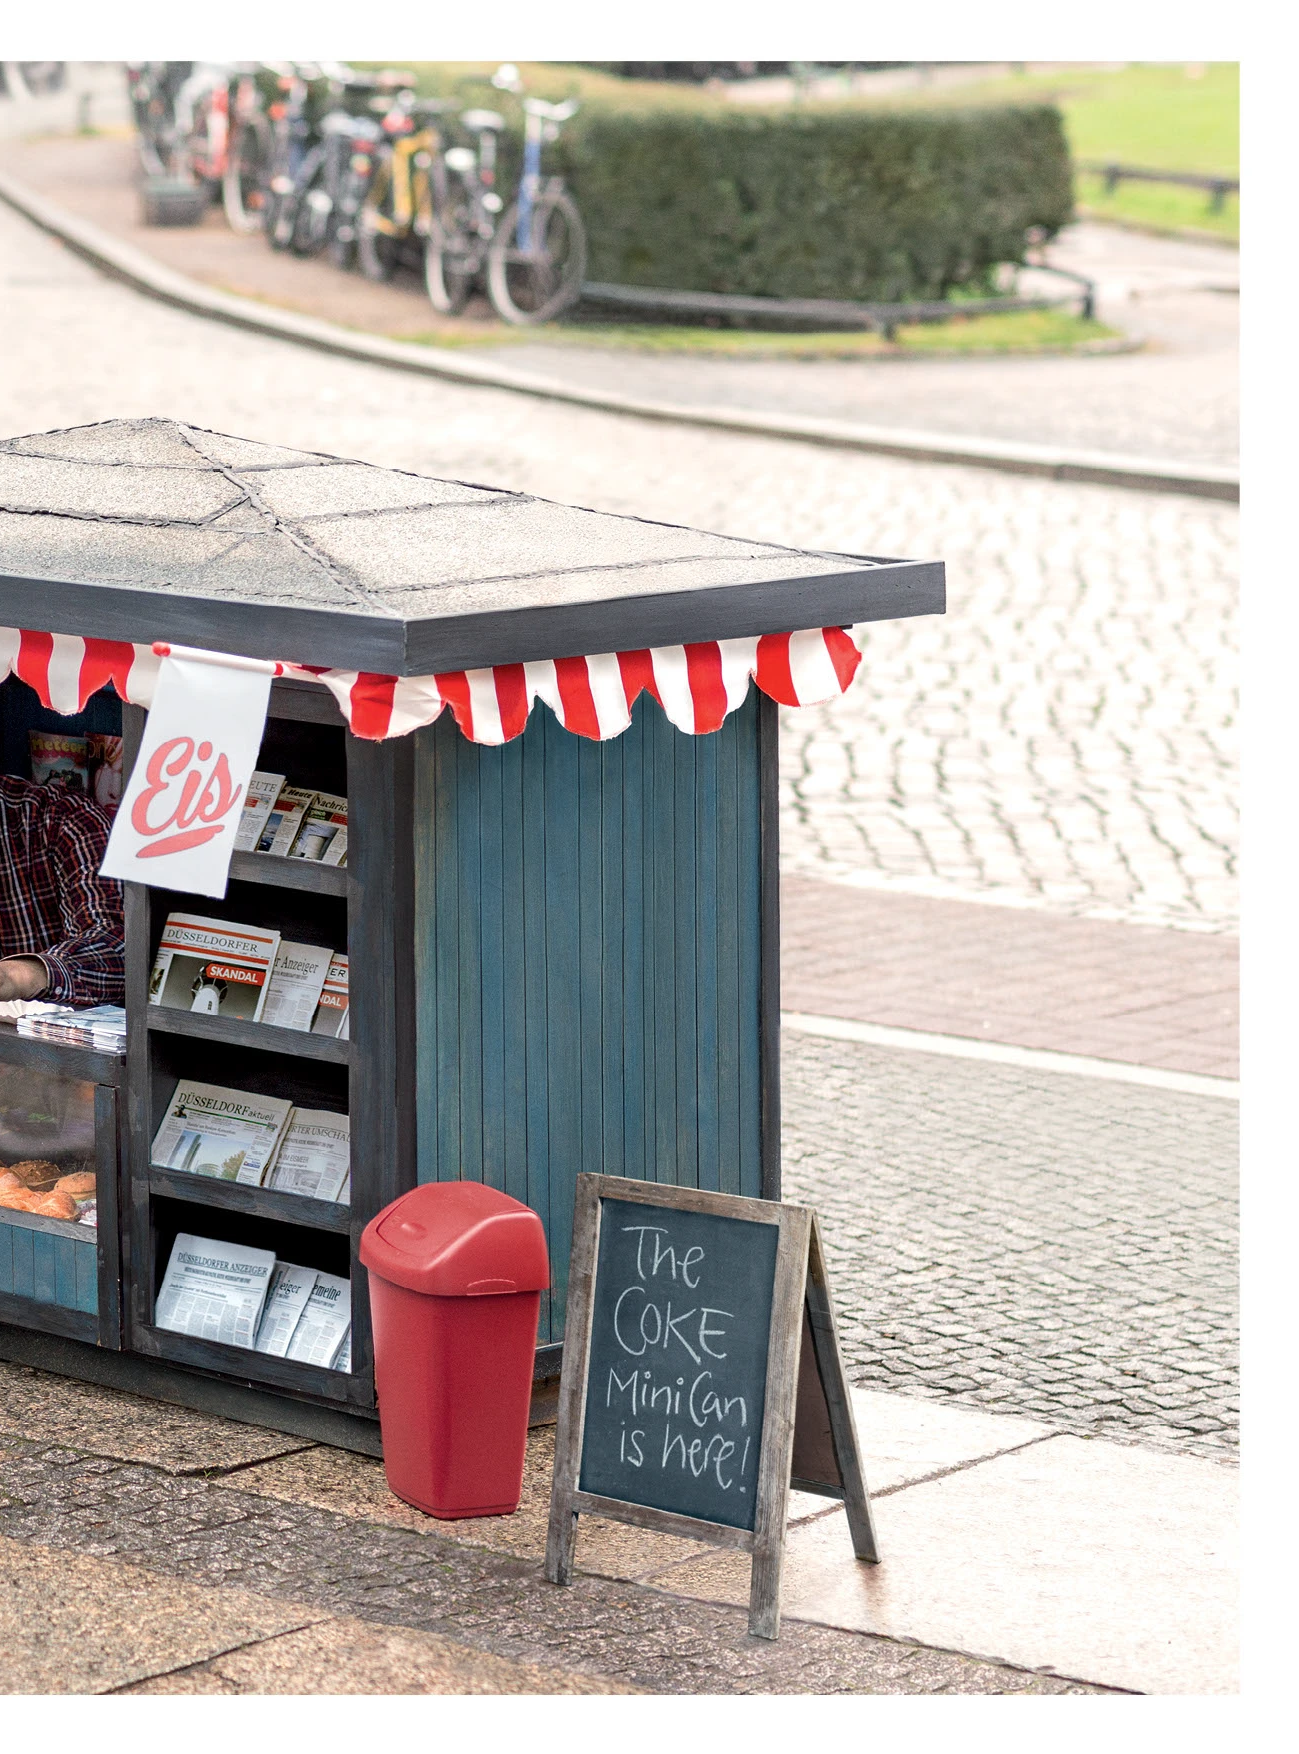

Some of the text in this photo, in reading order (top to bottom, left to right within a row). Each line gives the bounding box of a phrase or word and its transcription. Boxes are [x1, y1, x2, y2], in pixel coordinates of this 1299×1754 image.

[131, 736, 243, 836] Eis
[167, 928, 258, 953] DÜSSELDORFER
[210, 965, 258, 984] SKANDAL
[280, 956, 320, 976] Anzeiger
[177, 1251, 229, 1271] DÜSSELDORFER
[230, 1262, 269, 1277] ANZEIGER
[621, 1225, 705, 1289] The
[280, 1280, 302, 1295] eiger
[614, 1286, 735, 1366] COKE
[619, 1420, 751, 1493] is here!
